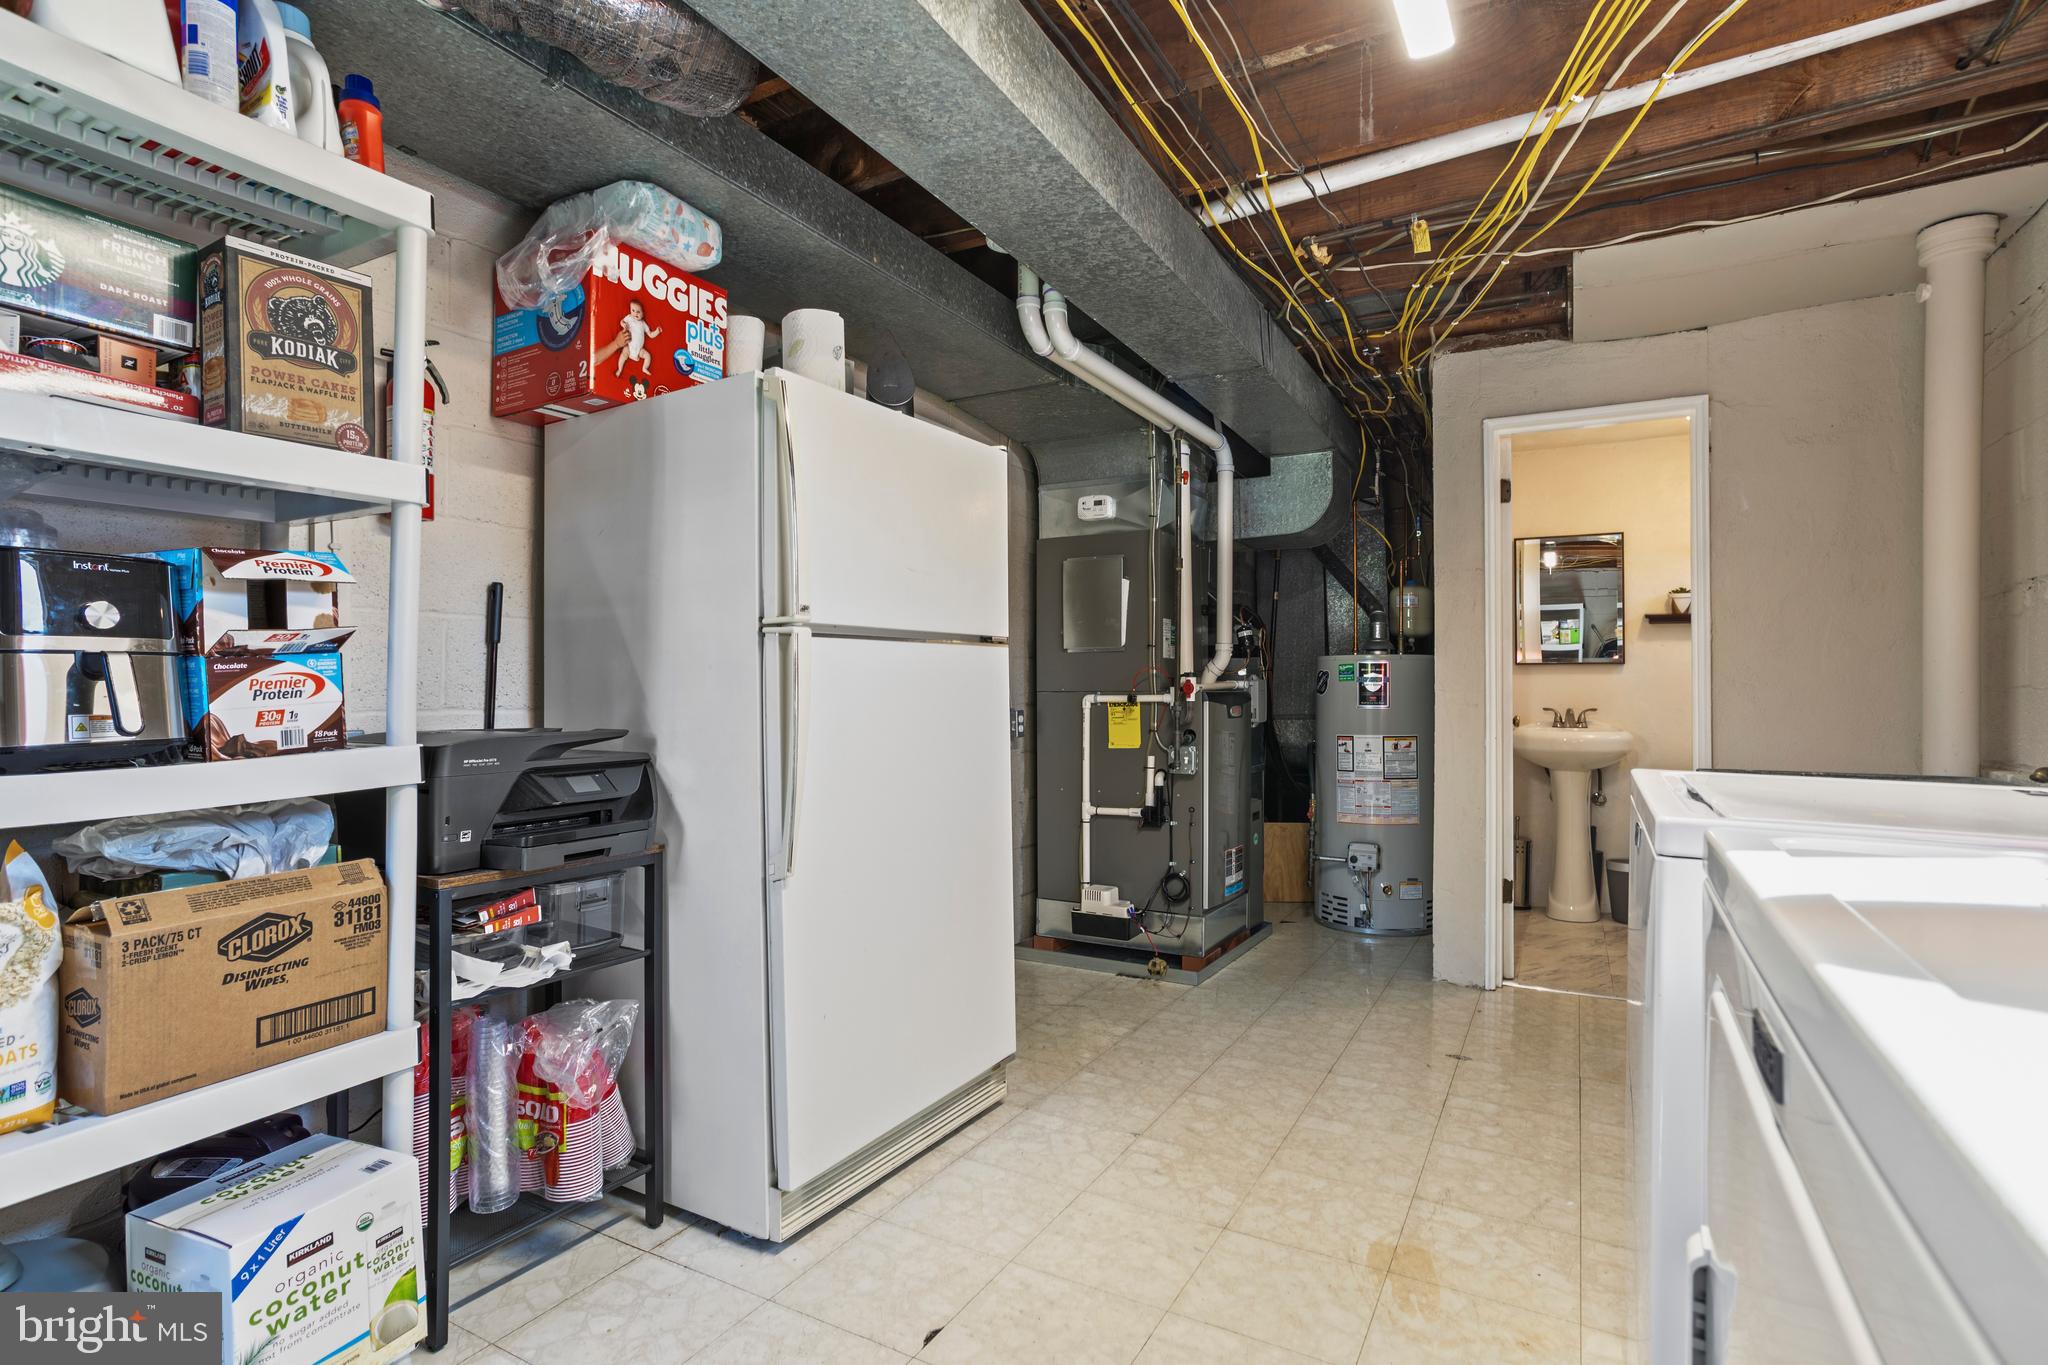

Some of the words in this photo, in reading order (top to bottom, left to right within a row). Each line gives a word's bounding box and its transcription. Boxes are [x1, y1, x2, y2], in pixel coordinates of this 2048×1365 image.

[102, 238, 168, 268] FRENCH
[270, 251, 335, 274] PROTEIN-PACKED
[100, 282, 130, 297] DARK
[132, 292, 168, 307] ROAST
[264, 276, 282, 289] 100%
[282, 275, 312, 286] WHOLE
[313, 283, 342, 307] GRAINS
[592, 238, 727, 329] HUGGIES
[687, 321, 723, 351] plus
[271, 336, 339, 370] KODIAK
[691, 350, 721, 366] snugglers
[699, 344, 714, 355] little
[250, 366, 306, 385] POWER
[311, 379, 358, 396] CAKES
[578, 360, 588, 378] 2
[152, 388, 184, 400] Plancha
[250, 376, 296, 391] FLAPJACK
[306, 387, 338, 399] WAFFLE
[340, 394, 356, 402] MIX
[279, 421, 333, 435] BUTTERMILK
[73, 560, 109, 571] Instant
[255, 559, 313, 570] Premier
[263, 566, 314, 577] Protein
[213, 662, 248, 671] Chocolate
[249, 676, 309, 691] Premier
[252, 687, 304, 701] Protein
[260, 711, 281, 722] 30g
[289, 710, 299, 720] 1g
[314, 730, 323, 738] 18
[323, 729, 338, 737] Pack
[348, 893, 381, 908] 44600
[334, 904, 381, 928] 31181
[353, 919, 381, 934] FM03
[122, 941, 129, 953] 3
[133, 930, 184, 950] PACK/75
[187, 927, 202, 940] CT
[227, 912, 306, 962] CLOROX
[121, 949, 154, 960] 1-FRESH
[155, 944, 178, 954] SCENT
[121, 955, 151, 968] 2-CRISP
[221, 957, 309, 985] DISINFECTING
[67, 998, 99, 1017] CLOROX
[120, 1091, 133, 1100] Made
[200, 1154, 314, 1205] coconut
[224, 1163, 305, 1201] water
[240, 1272, 250, 1281] 9
[250, 1263, 259, 1272] x
[264, 1229, 286, 1253] Liter
[288, 1235, 333, 1261] KIRKLAND
[366, 1236, 415, 1269] coconut
[141, 1262, 171, 1280] organic
[275, 1250, 344, 1293] organic
[373, 1249, 410, 1275] water
[131, 1269, 183, 1292] coconut
[249, 1251, 365, 1326] coconut
[266, 1279, 351, 1337] water
[272, 1337, 285, 1350] no
[289, 1320, 316, 1339] sugar
[319, 1300, 349, 1322] added
[280, 1335, 303, 1353] from
[306, 1303, 361, 1338] concentrate
